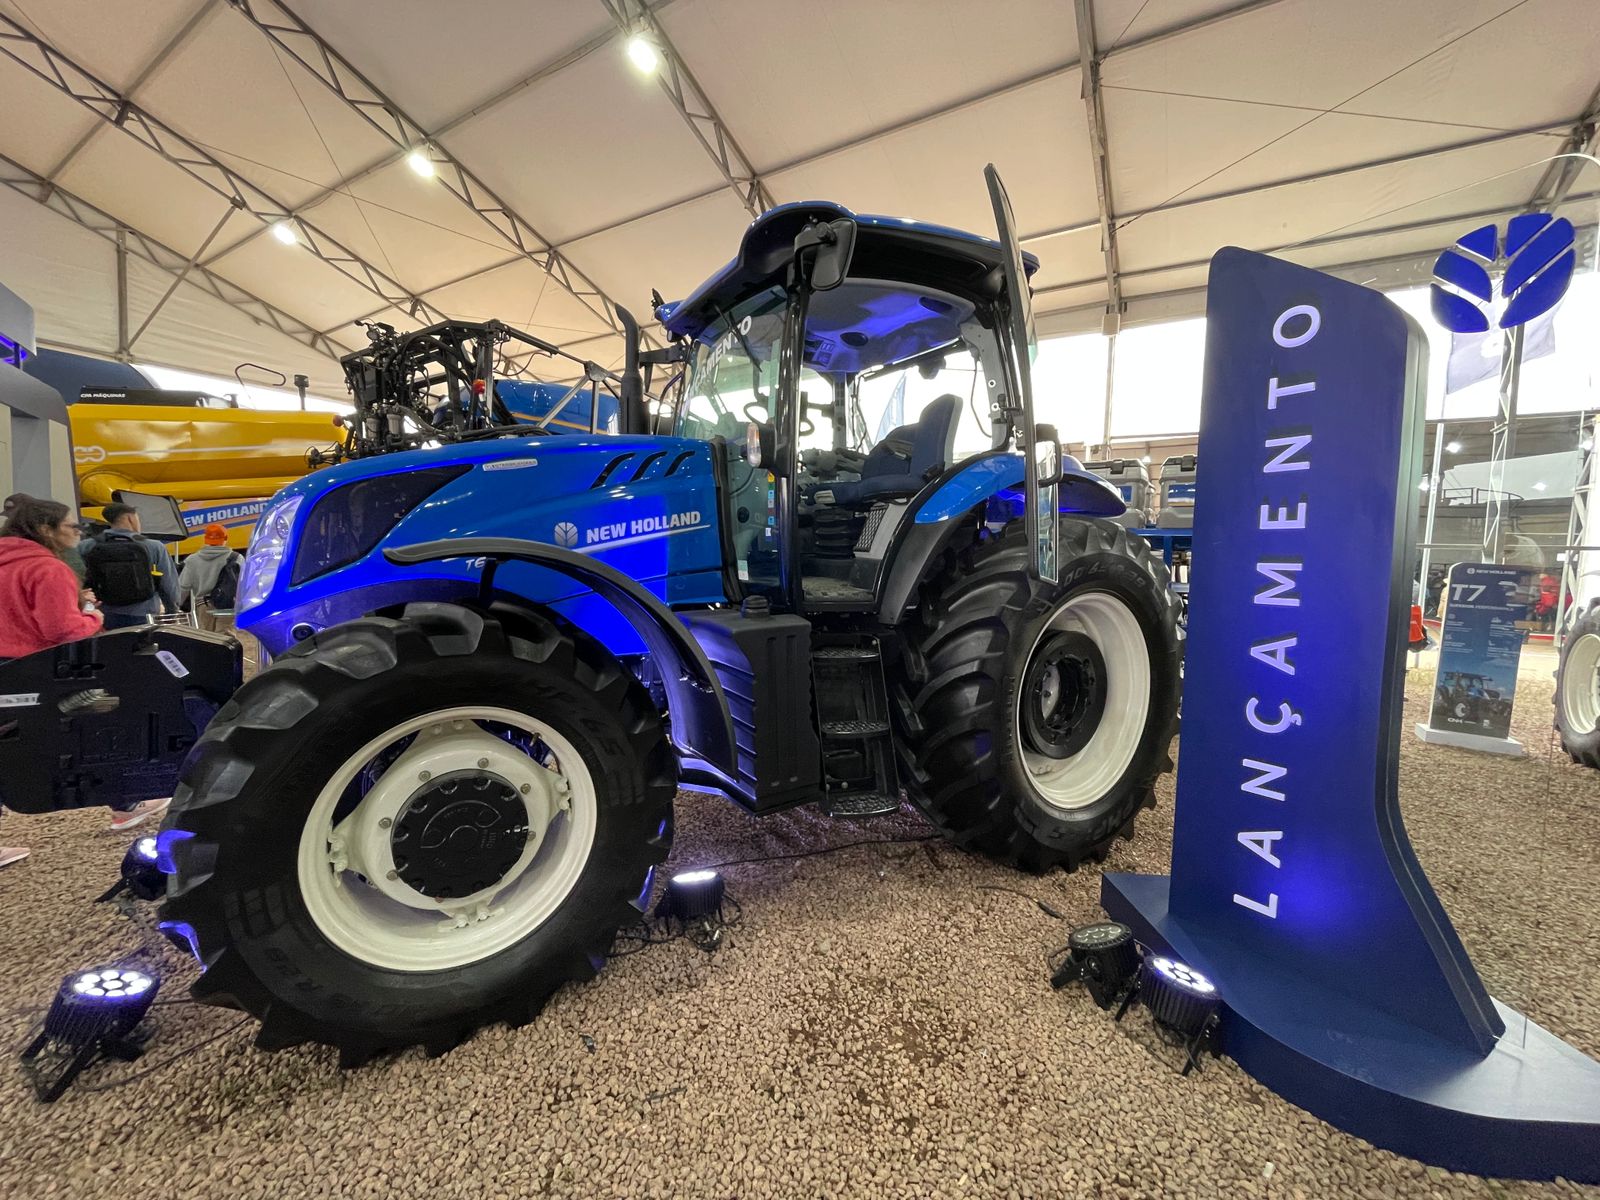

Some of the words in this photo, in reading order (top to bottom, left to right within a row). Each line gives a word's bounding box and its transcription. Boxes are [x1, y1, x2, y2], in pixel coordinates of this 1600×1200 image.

[184, 514, 204, 527] EW
[586, 522, 627, 544] NEW
[631, 511, 701, 535] HOLLAND
[1451, 583, 1487, 602] T7
[1233, 304, 1322, 919] LANÇAMENTO
